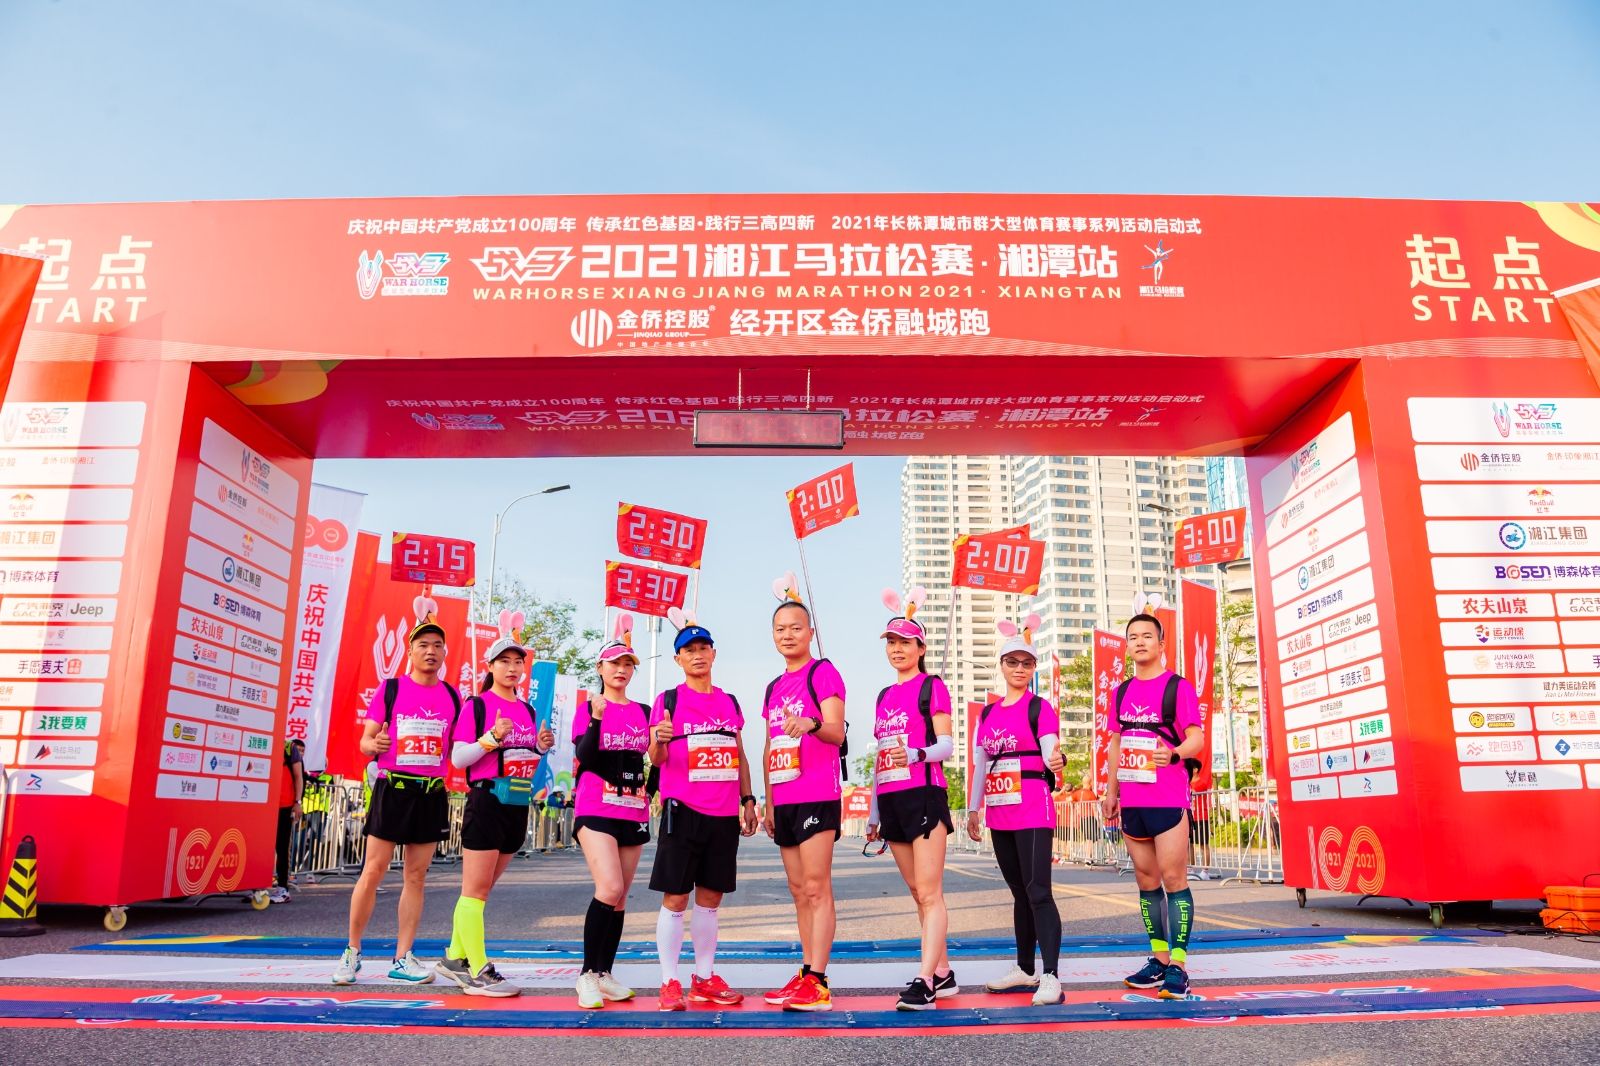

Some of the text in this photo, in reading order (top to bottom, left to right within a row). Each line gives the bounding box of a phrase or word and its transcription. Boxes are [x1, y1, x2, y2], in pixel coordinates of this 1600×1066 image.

[348, 217, 577, 235] 庆祝中国共产党成立100周年
[831, 215, 1202, 234] 2021年长株潭城市群大型体育赛事系列活动启动式
[1405, 234, 1549, 291] 起点
[385, 278, 447, 286] WAR HORSE
[473, 285, 1121, 300] WARHORSE XIANG JIANG MARATHON 2021 XIANGTAN
[32, 297, 147, 323] TART
[1411, 294, 1555, 323] START
[617, 310, 710, 329] 金侨控股
[730, 308, 991, 337] 经开区金侨融城跑
[1515, 422, 1562, 430] WAR HORSE
[1480, 453, 1521, 463] 金侨控股
[797, 473, 844, 519] 2:00
[629, 511, 694, 550] 2:30
[1183, 515, 1236, 550] 3:00
[1528, 527, 1588, 540] 湘江集团
[404, 539, 465, 570] 2:15
[966, 541, 1031, 575] 2:00
[617, 568, 678, 603] 2:30
[70, 603, 103, 617] Jeep
[1463, 598, 1528, 614] 农夫山泉
[192, 616, 224, 640] 农夫山泉
[1355, 613, 1371, 626] Jeep
[1493, 627, 1524, 636] 运动保
[264, 643, 278, 656] Jeep
[285, 583, 328, 739] 庆祝中国共产党
[404, 739, 437, 753] 2:15
[697, 752, 732, 767] 2:30
[770, 752, 791, 770] 2:00
[1119, 753, 1147, 768] 3:00
[986, 776, 1014, 793] 3:00
[186, 853, 239, 870] 1921 2021
[1325, 852, 1376, 868] 1921 2021
